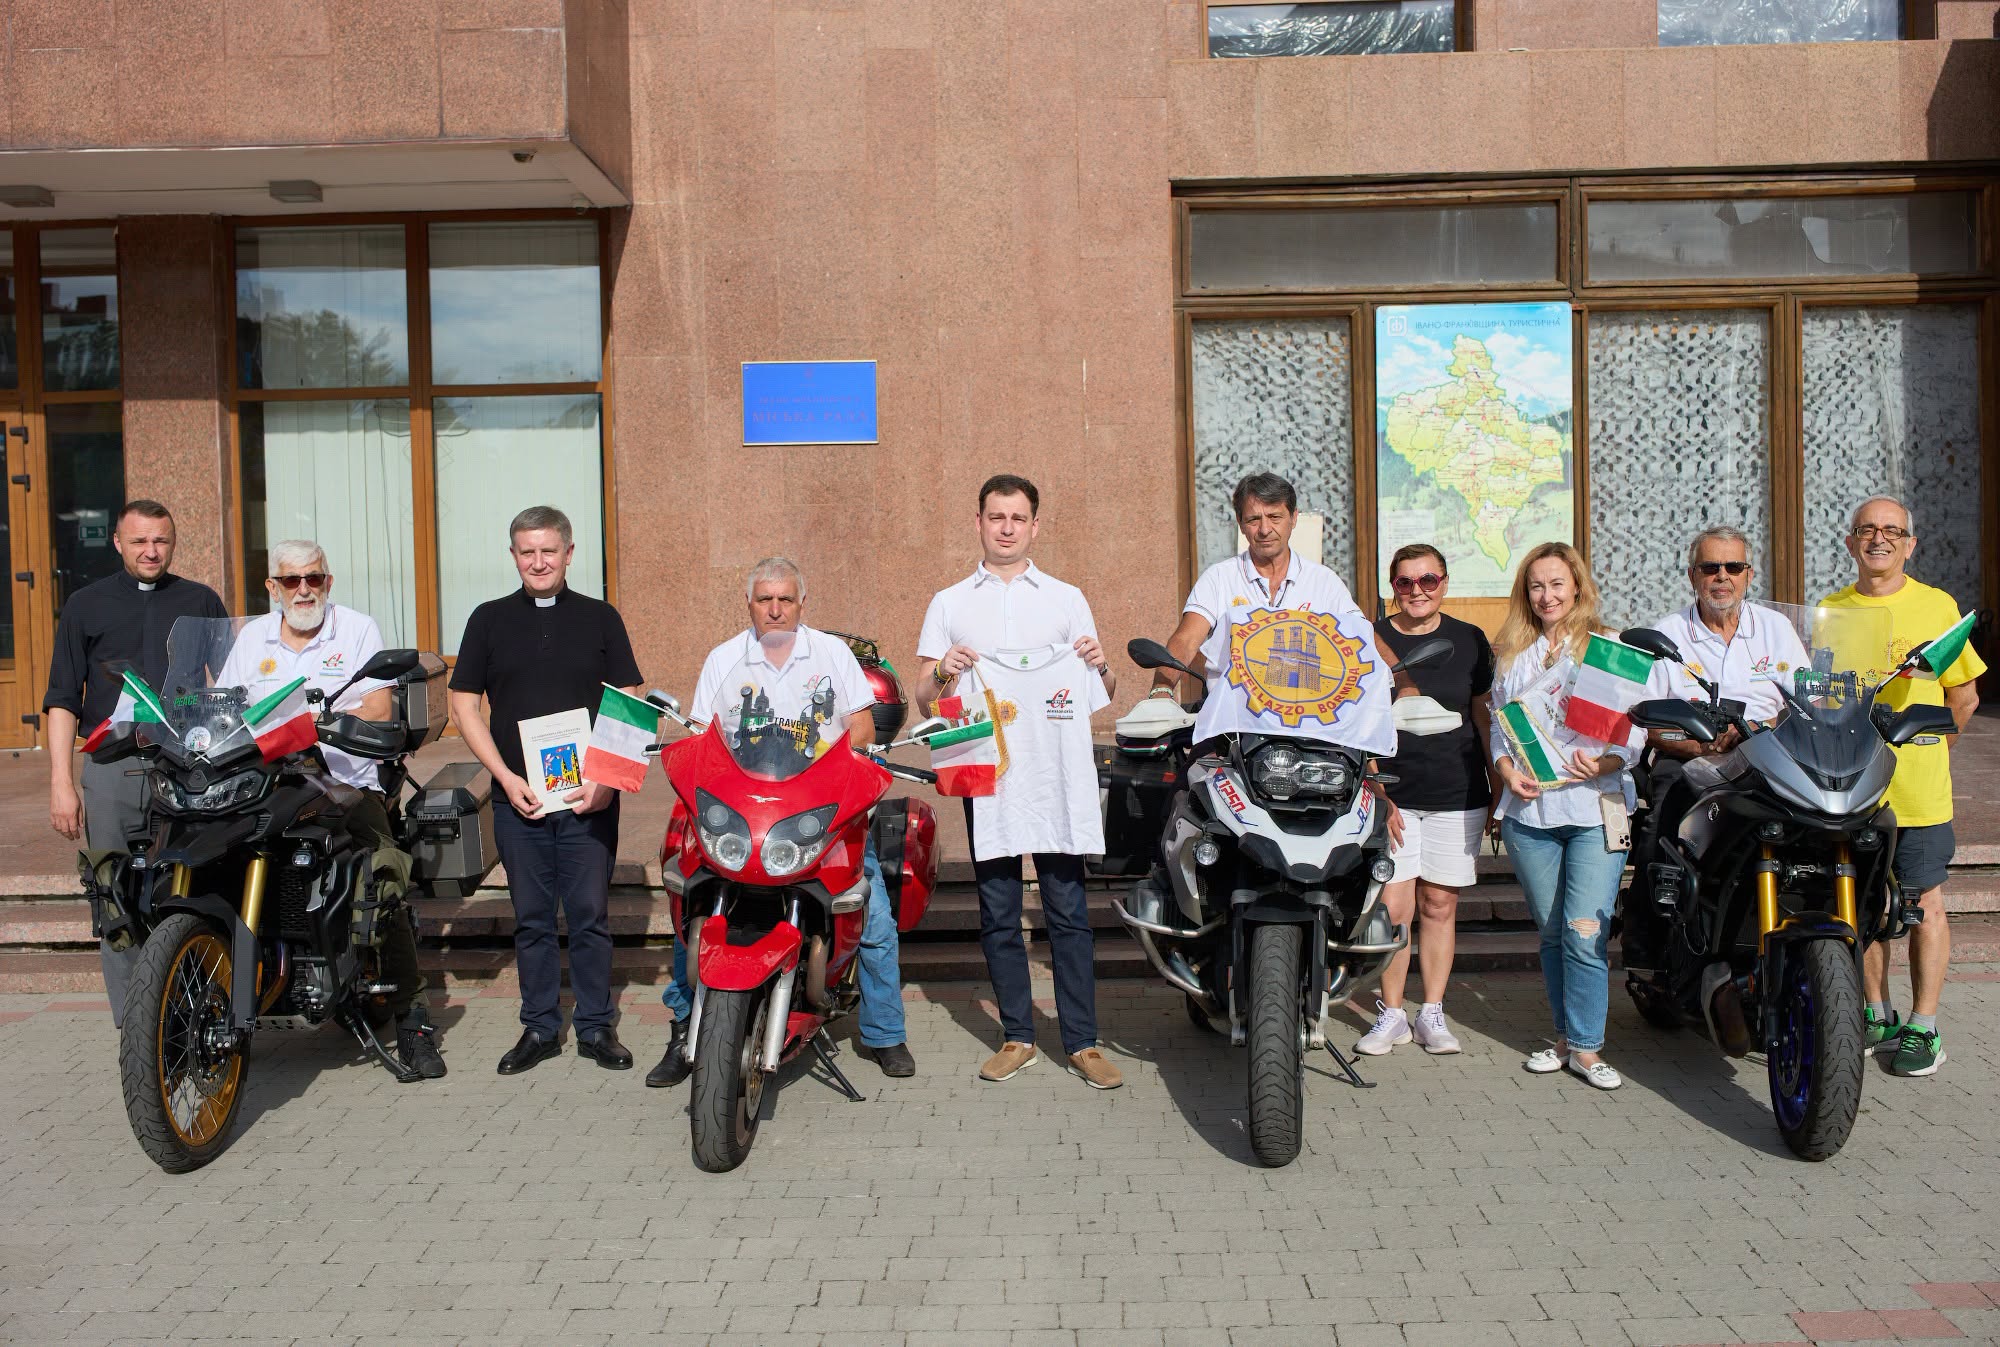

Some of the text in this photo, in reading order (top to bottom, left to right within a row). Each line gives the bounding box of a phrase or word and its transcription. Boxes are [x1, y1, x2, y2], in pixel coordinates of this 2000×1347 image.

[1235, 611, 1355, 658] MOTO CLUB
[1230, 647, 1360, 716] CASTELLAZZO BORMIDA
[774, 717, 811, 733] TRAVELS
[776, 728, 810, 744] WHEELS
